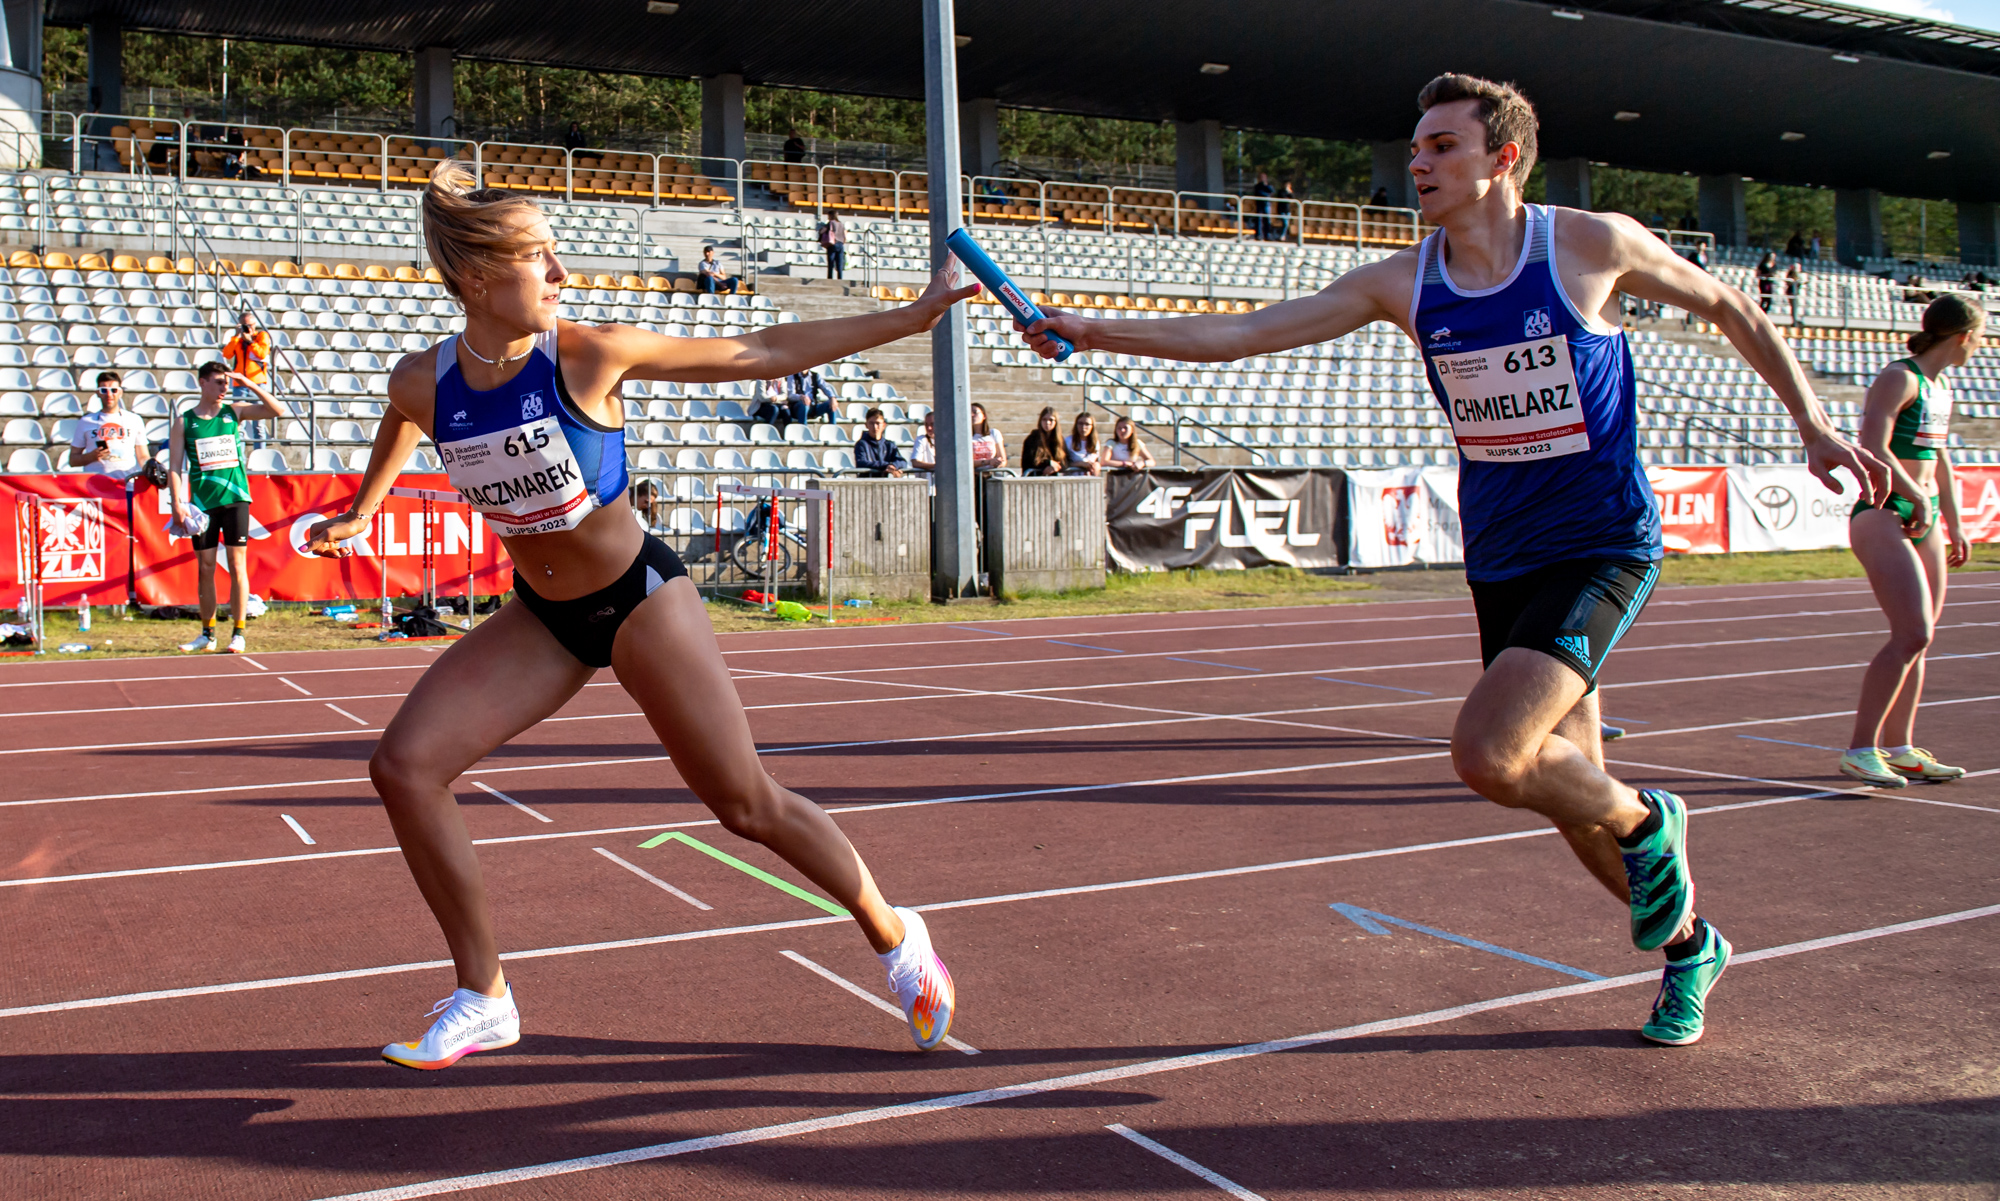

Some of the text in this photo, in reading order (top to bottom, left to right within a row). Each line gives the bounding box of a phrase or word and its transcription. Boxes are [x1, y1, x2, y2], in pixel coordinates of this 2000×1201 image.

[1450, 356, 1487, 367] Akademia
[1452, 363, 1489, 374] Pomorska
[1503, 345, 1557, 374] 613
[1453, 383, 1574, 423] CHMIELARZ
[219, 437, 232, 446] 306
[503, 426, 550, 458] 615
[1508, 434, 1528, 443] Polski
[1535, 427, 1574, 440] Sztafetach
[455, 441, 489, 455] Akademia
[457, 449, 492, 462] Pomorska
[1485, 443, 1552, 457] SŁUPSK 2023
[459, 459, 578, 507] KACZMAREK
[525, 513, 543, 523] Polski
[550, 497, 582, 515] Sztafetach
[1136, 486, 1321, 549] 4F FUEL
[506, 518, 567, 535] SŁUPSK 2023
[1555, 636, 1593, 669] adidas
[444, 1012, 509, 1050] new balance
